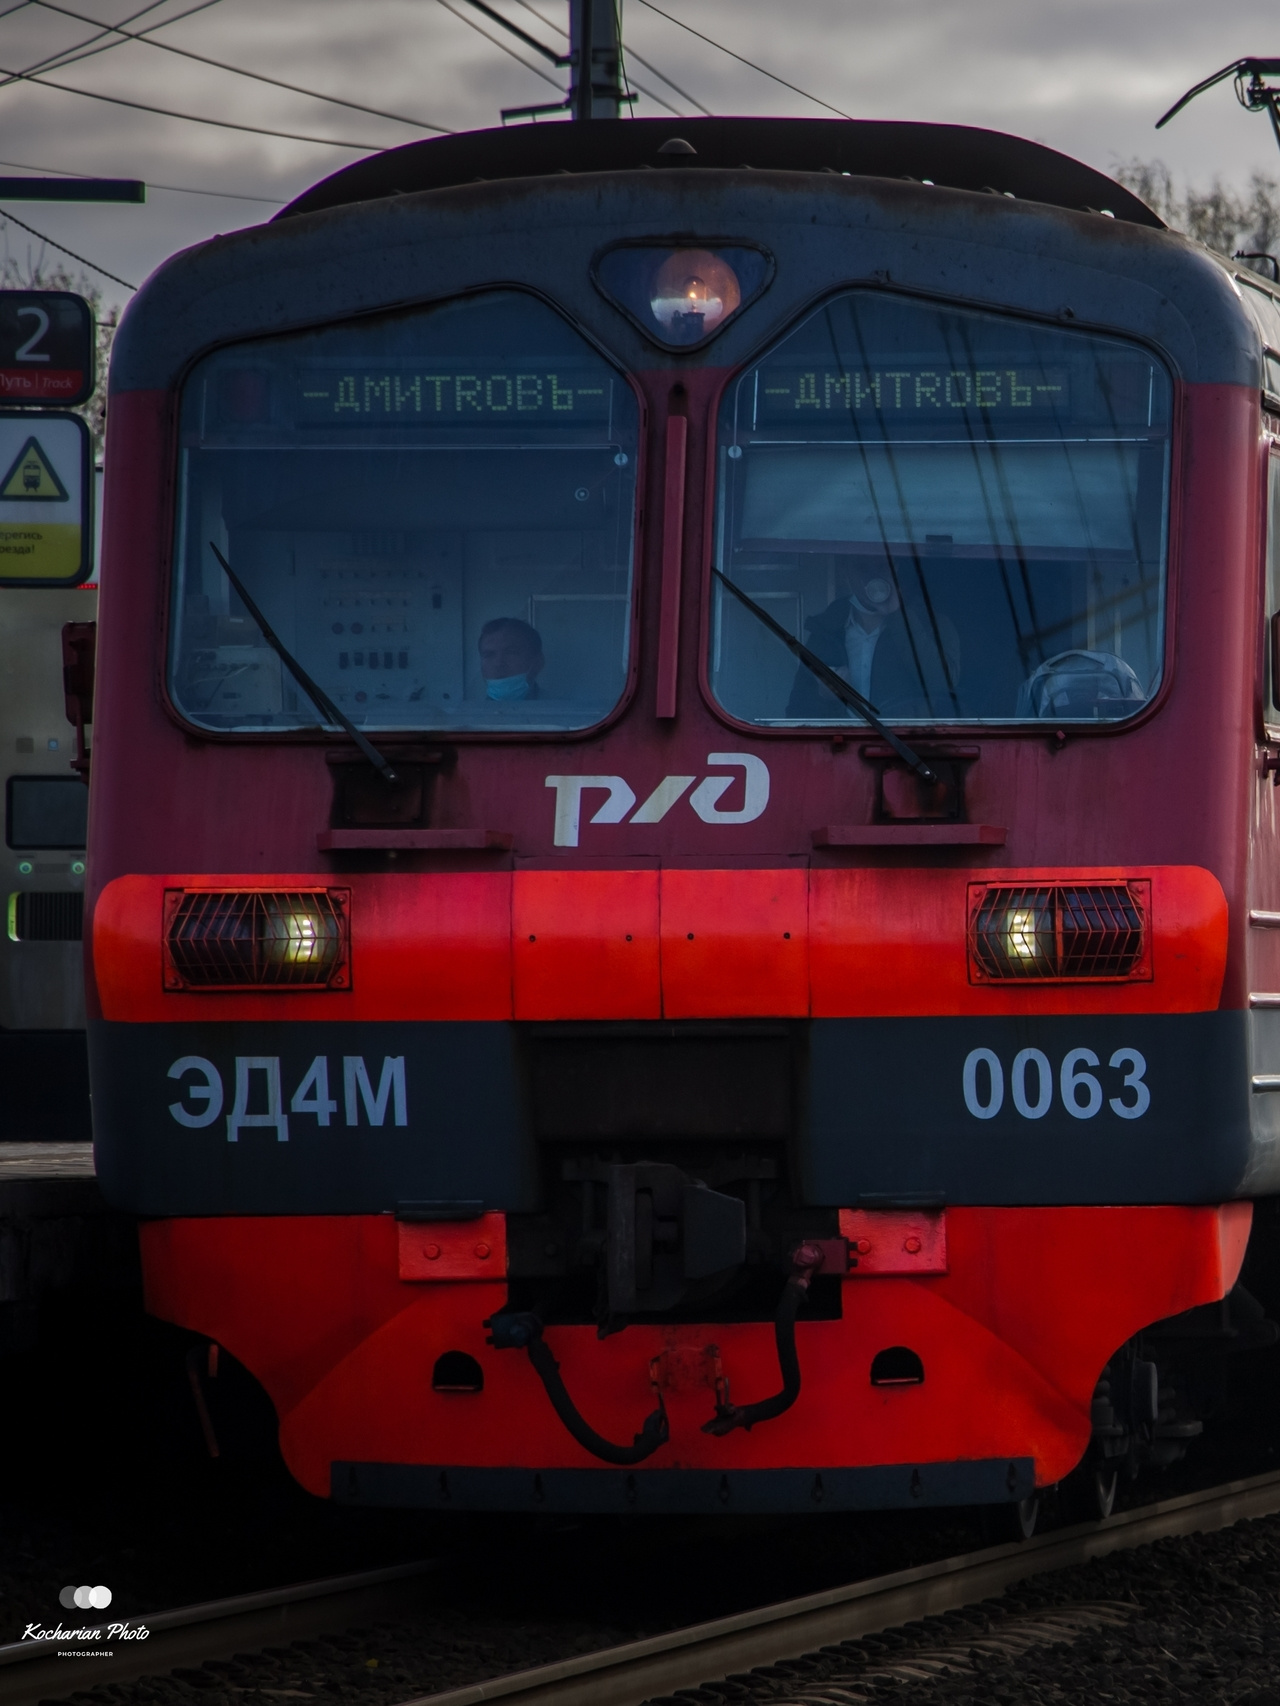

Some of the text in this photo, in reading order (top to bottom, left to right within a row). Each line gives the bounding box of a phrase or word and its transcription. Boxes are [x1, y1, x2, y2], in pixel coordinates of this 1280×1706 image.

[14, 306, 51, 362] 2
[43, 376, 73, 389] Track
[166, 1055, 408, 1142] ЭД4М
[962, 1047, 1151, 1120] 0063
